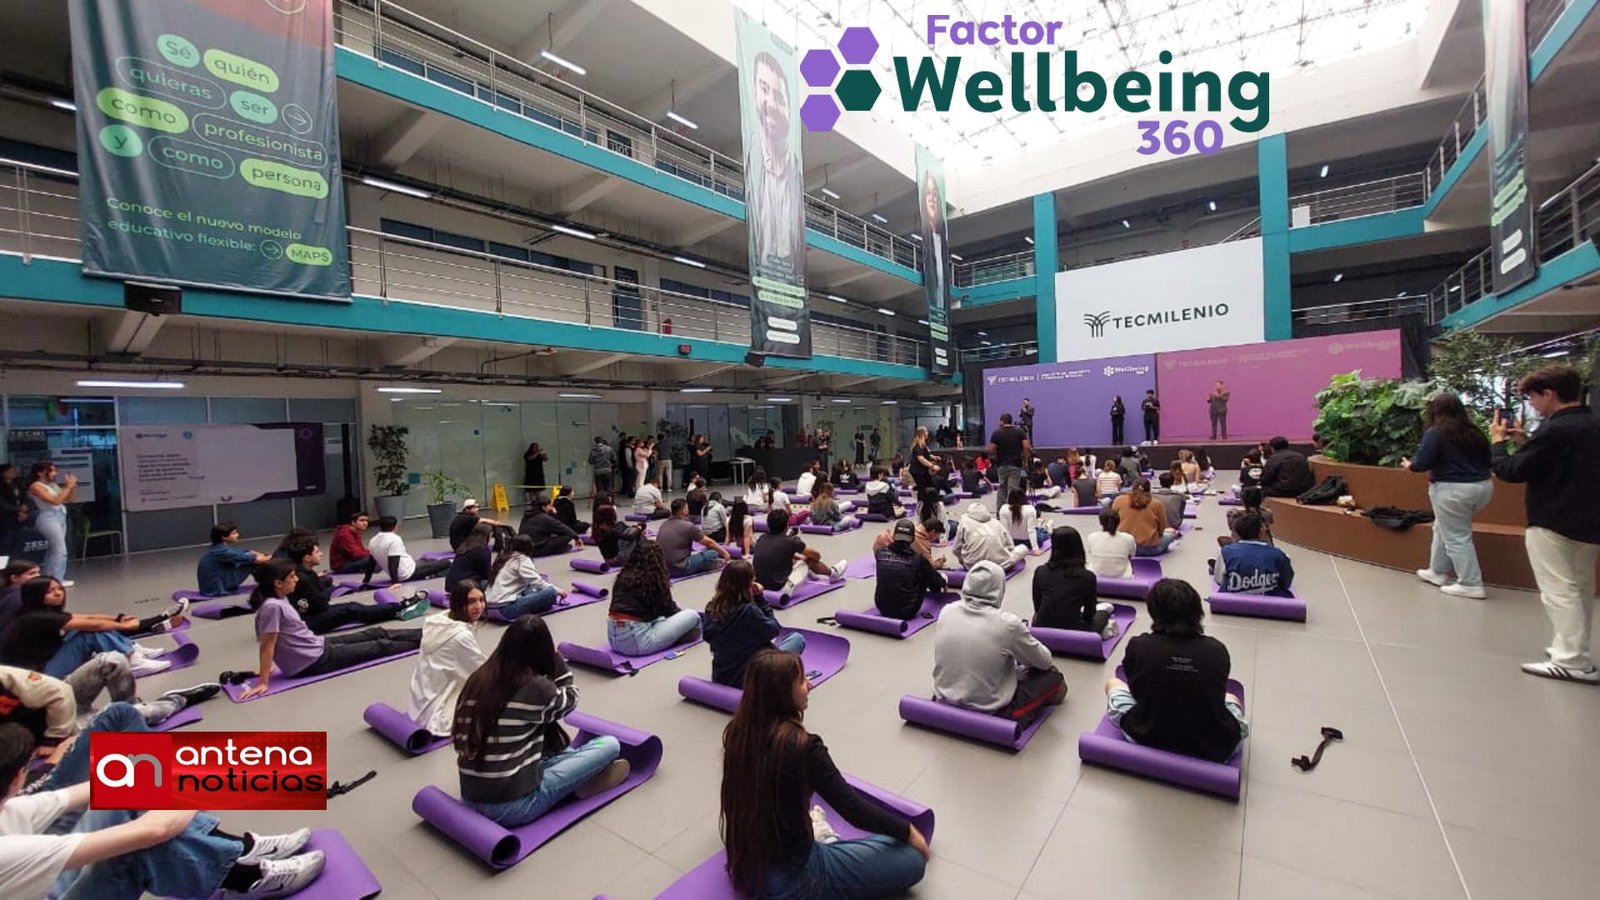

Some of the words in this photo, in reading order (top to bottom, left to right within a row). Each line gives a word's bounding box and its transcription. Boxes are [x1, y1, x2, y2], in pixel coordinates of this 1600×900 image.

[165, 40, 192, 60] Sé
[213, 57, 271, 85] quién
[129, 68, 213, 100] quieras
[240, 98, 269, 116] ser
[111, 97, 177, 124] como
[204, 121, 323, 161] profesionista
[113, 134, 129, 149] y
[162, 147, 224, 170] como
[252, 166, 321, 191] persona
[106, 197, 173, 219] Conoce
[177, 211, 191, 223] el
[196, 215, 244, 231] nuevo
[248, 224, 302, 241] modelo
[107, 220, 194, 243] educativo
[290, 249, 330, 263] MAPS
[1112, 303, 1230, 329] TECMILENIO
